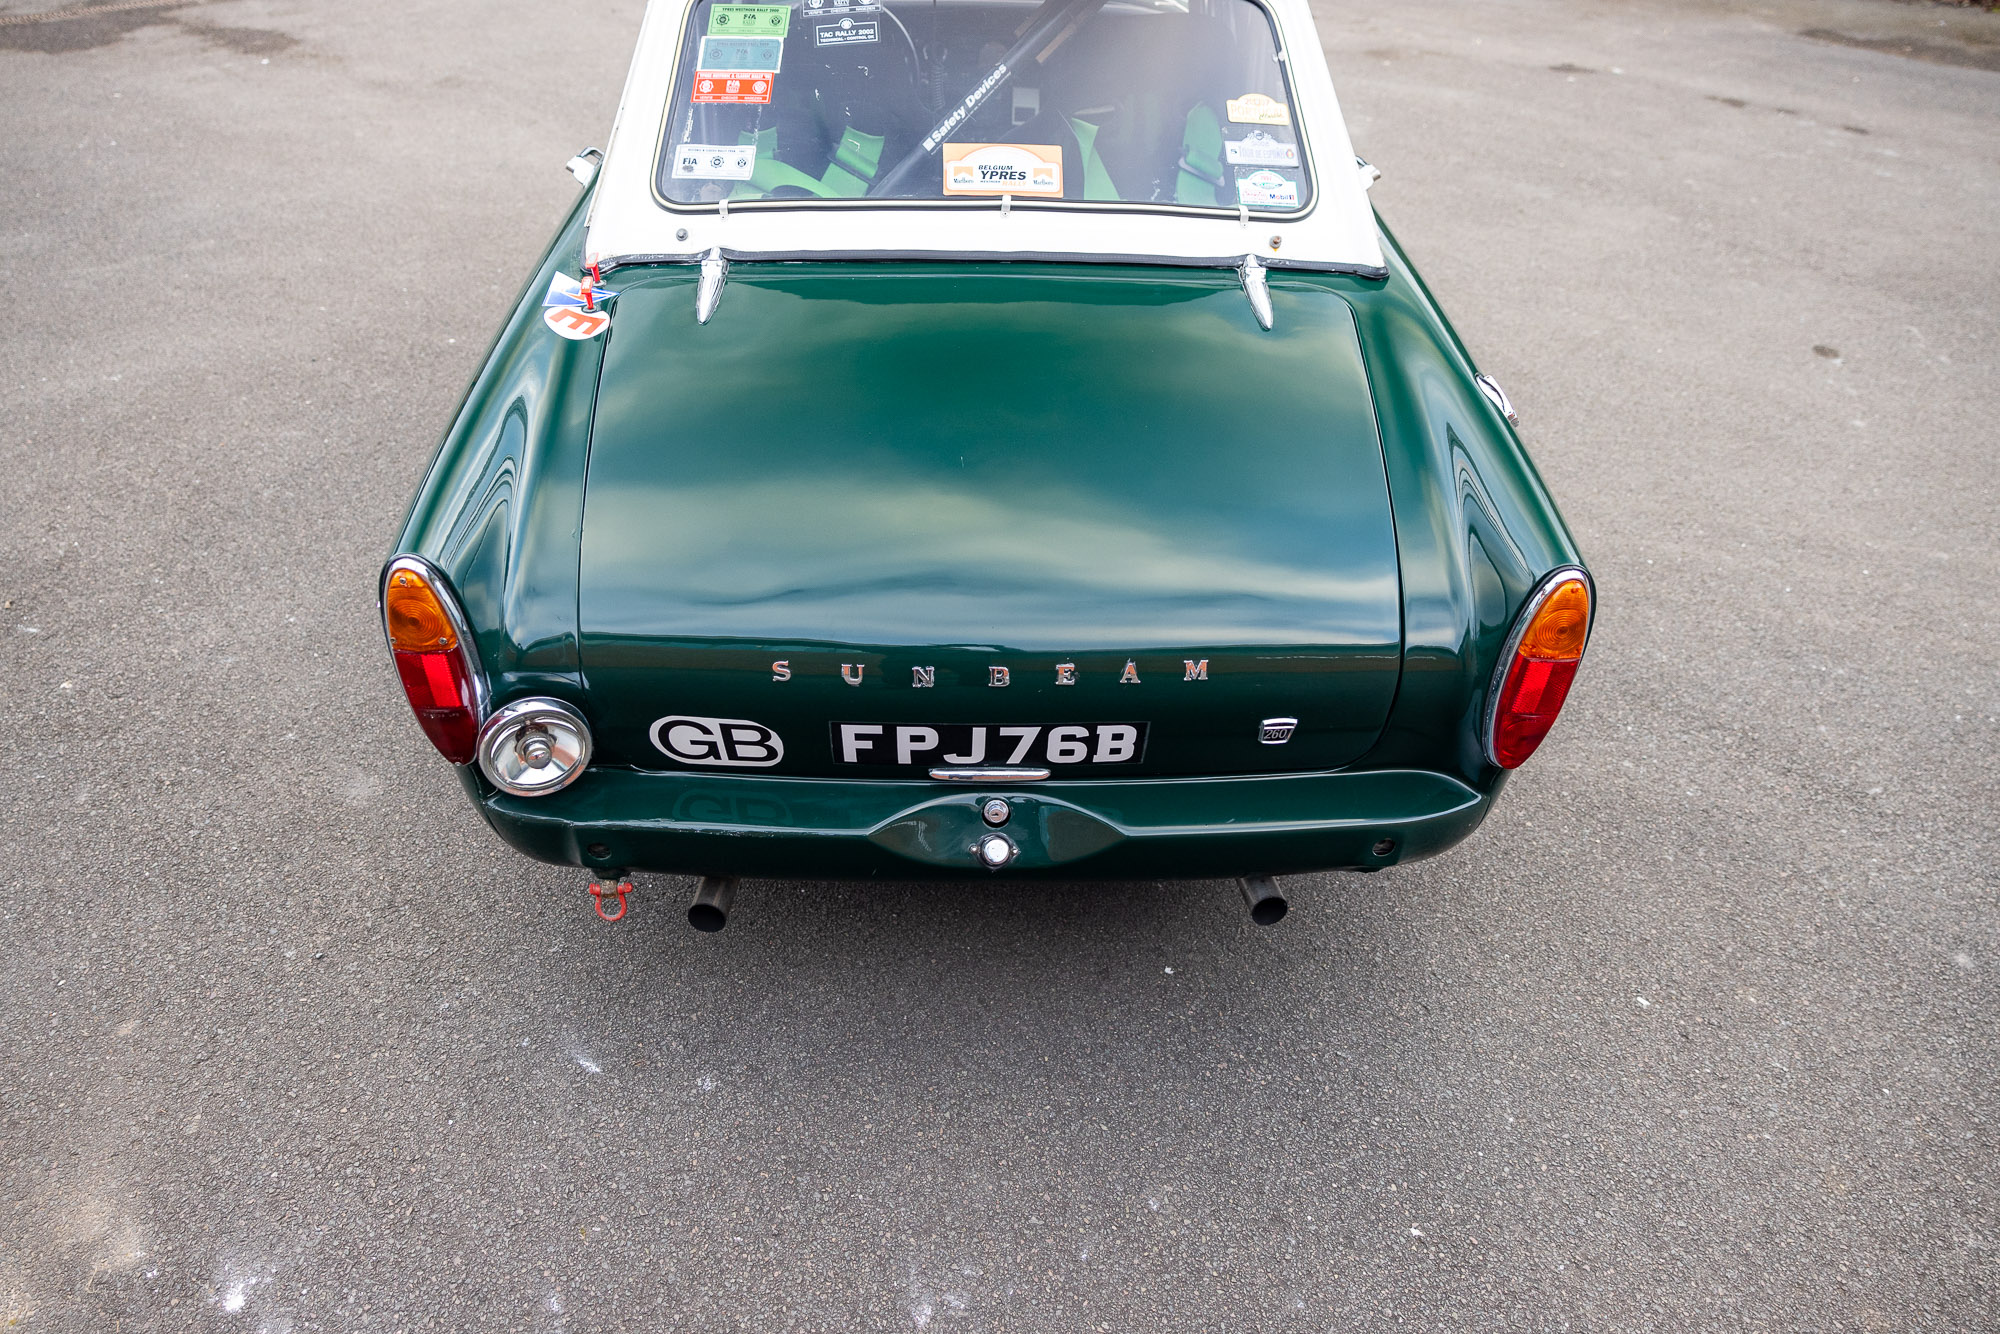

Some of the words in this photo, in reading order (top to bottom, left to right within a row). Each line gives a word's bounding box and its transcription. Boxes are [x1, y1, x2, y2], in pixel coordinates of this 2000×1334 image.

[835, 29, 857, 37] RALLY
[931, 105, 966, 143] Safety
[964, 63, 1007, 108] Devices
[682, 157, 698, 165] FIA
[980, 170, 1027, 181] YPRES
[1033, 178, 1054, 186] Marlboro
[548, 308, 607, 336] E
[772, 658, 1209, 689] SUNBEAM
[657, 719, 779, 763] GB
[1263, 728, 1288, 740] 260
[840, 724, 1138, 765] FPJ76B
